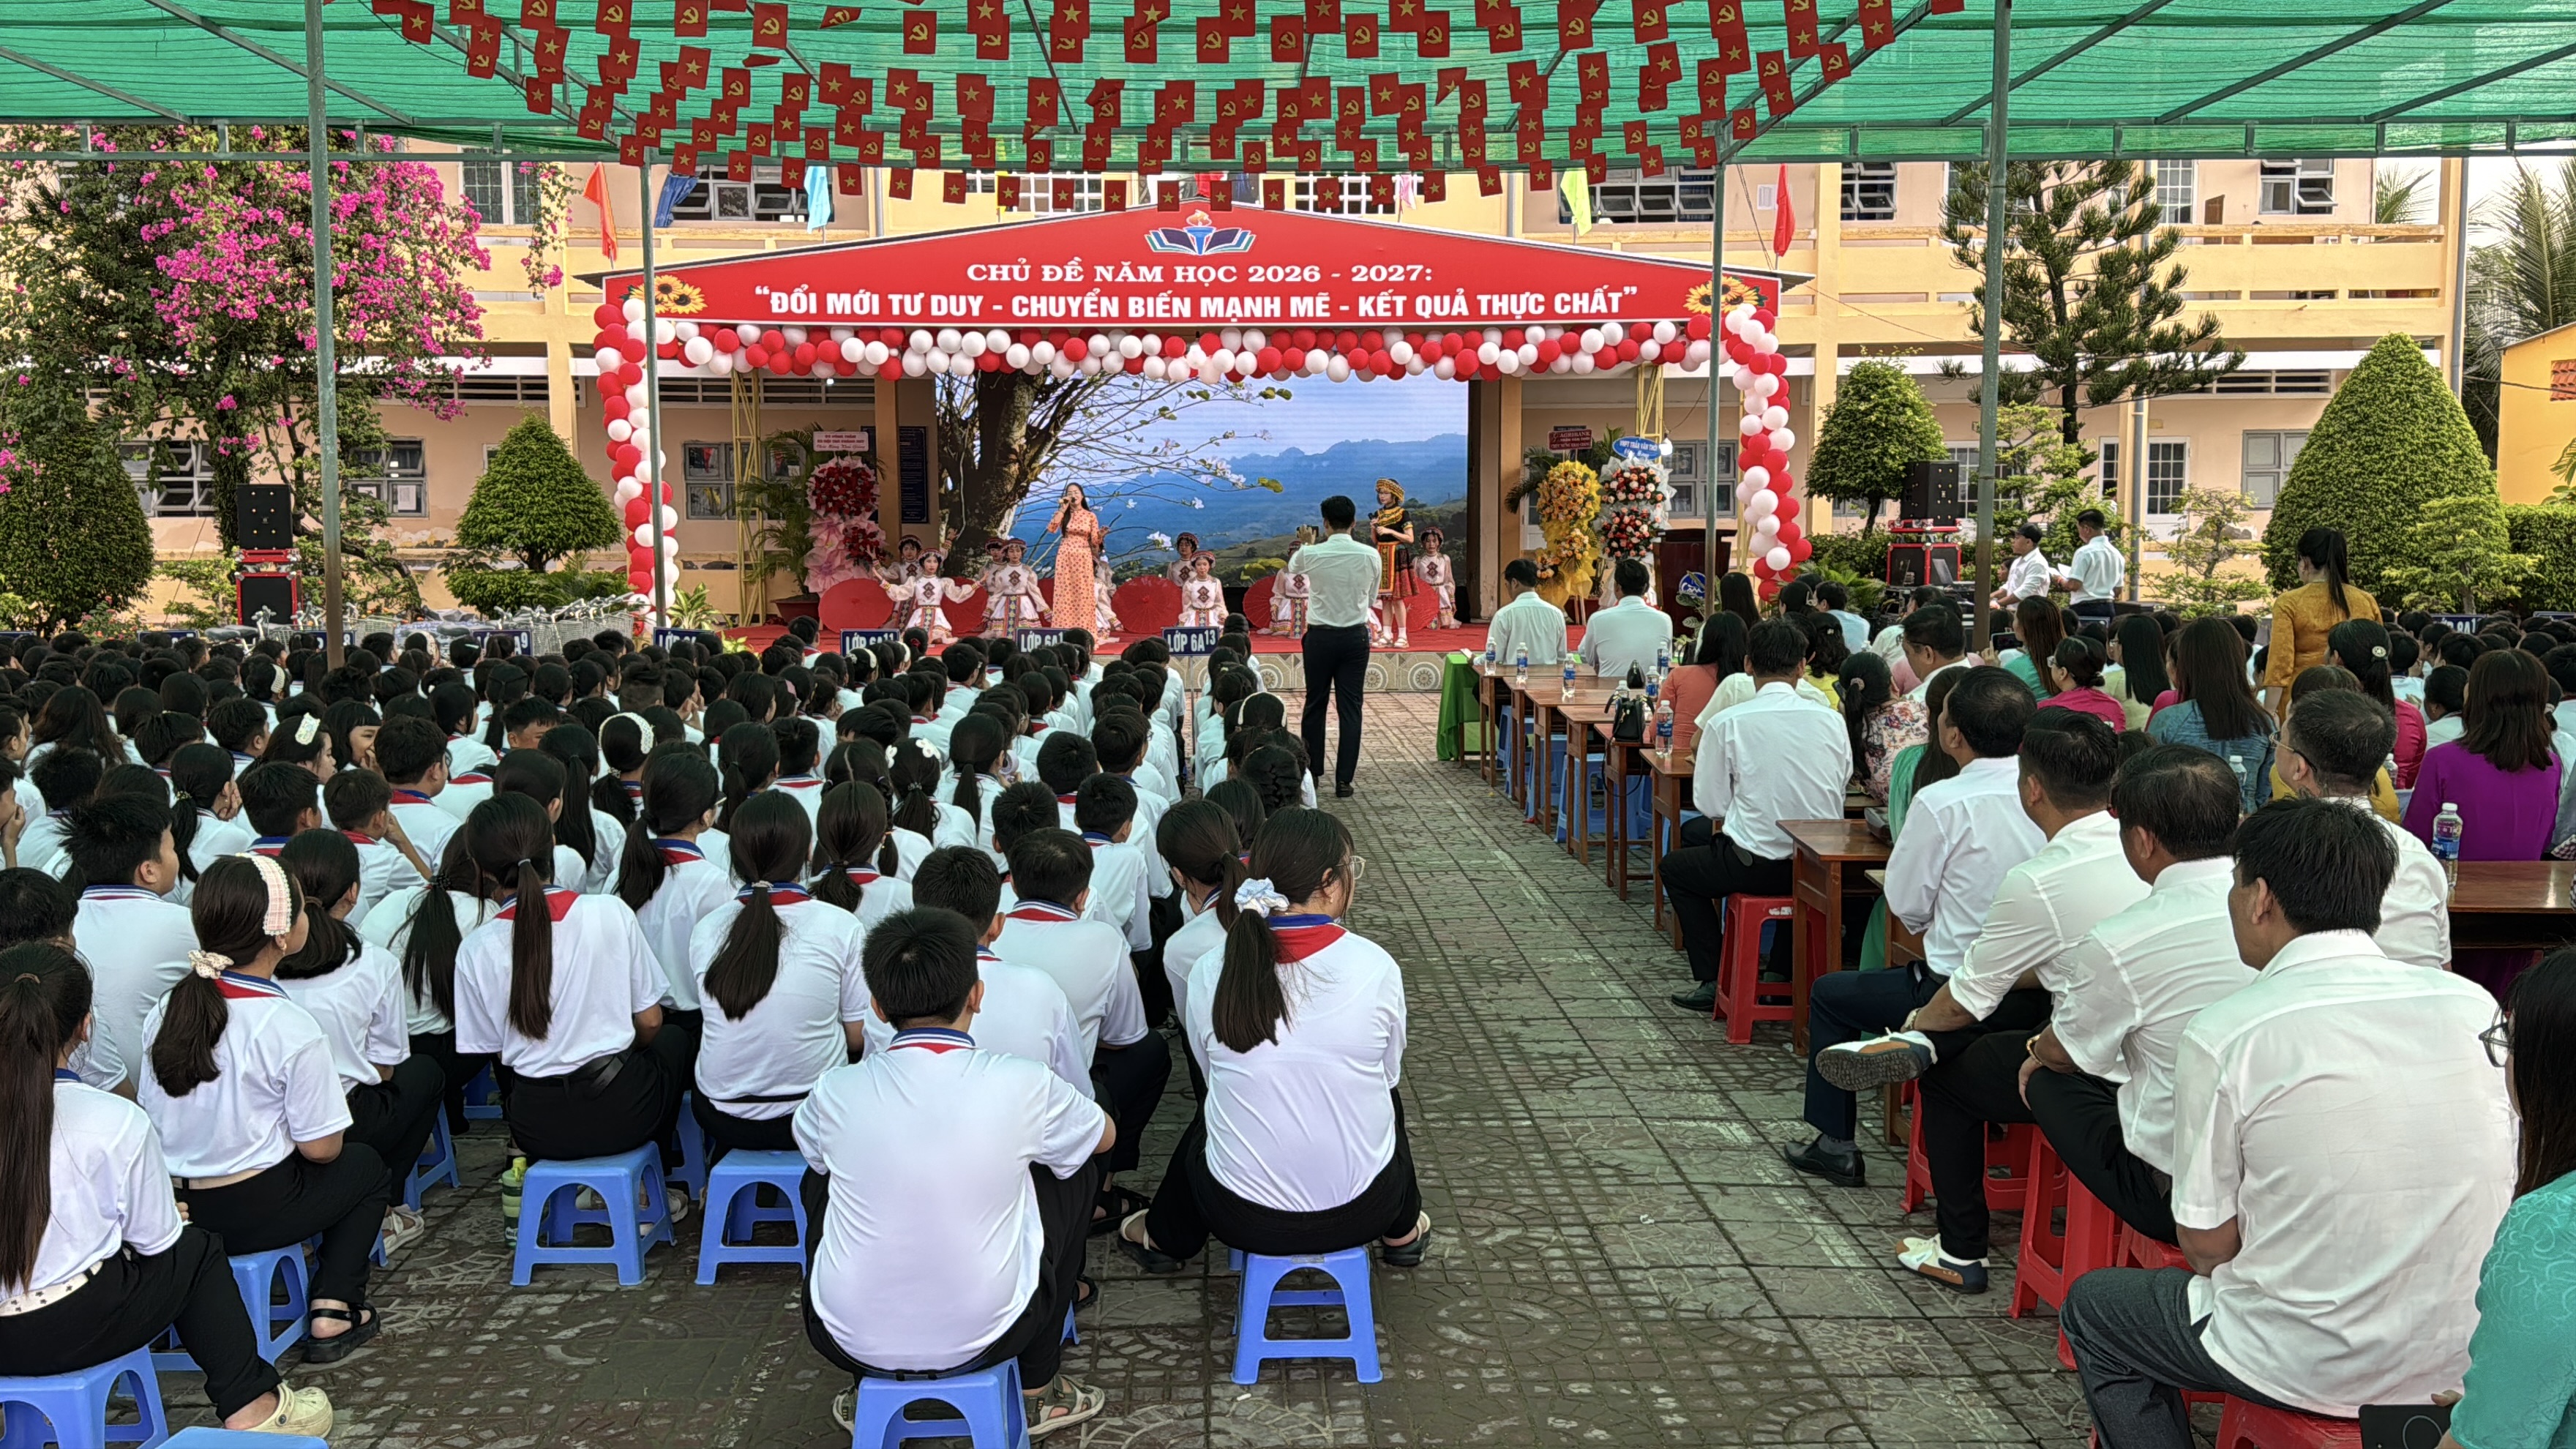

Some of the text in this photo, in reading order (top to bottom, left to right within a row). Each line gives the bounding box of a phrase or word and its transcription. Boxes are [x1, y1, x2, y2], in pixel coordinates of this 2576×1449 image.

[967, 257, 1031, 282] CHỦ
[1041, 256, 1085, 282] ĐỀ
[1093, 261, 1164, 282] NĂM
[1174, 264, 1238, 287] HỌC
[1248, 265, 1321, 282] 2026
[1351, 264, 1432, 282] 2027:
[826, 289, 880, 315] MỚI
[888, 292, 925, 315] TƯ
[930, 294, 984, 317] DUY
[1011, 288, 1120, 318] CHUYỂN
[1128, 290, 1191, 318] BIẾN
[1200, 296, 1281, 323] MẠNH
[1289, 292, 1330, 318] MẼ
[1358, 288, 1407, 318] KẾT
[1415, 288, 1469, 319] QUẢ
[1476, 291, 1545, 320] THỰC
[1020, 630, 1042, 653] LỚP
[1167, 629, 1216, 653] LỚP 6A13
